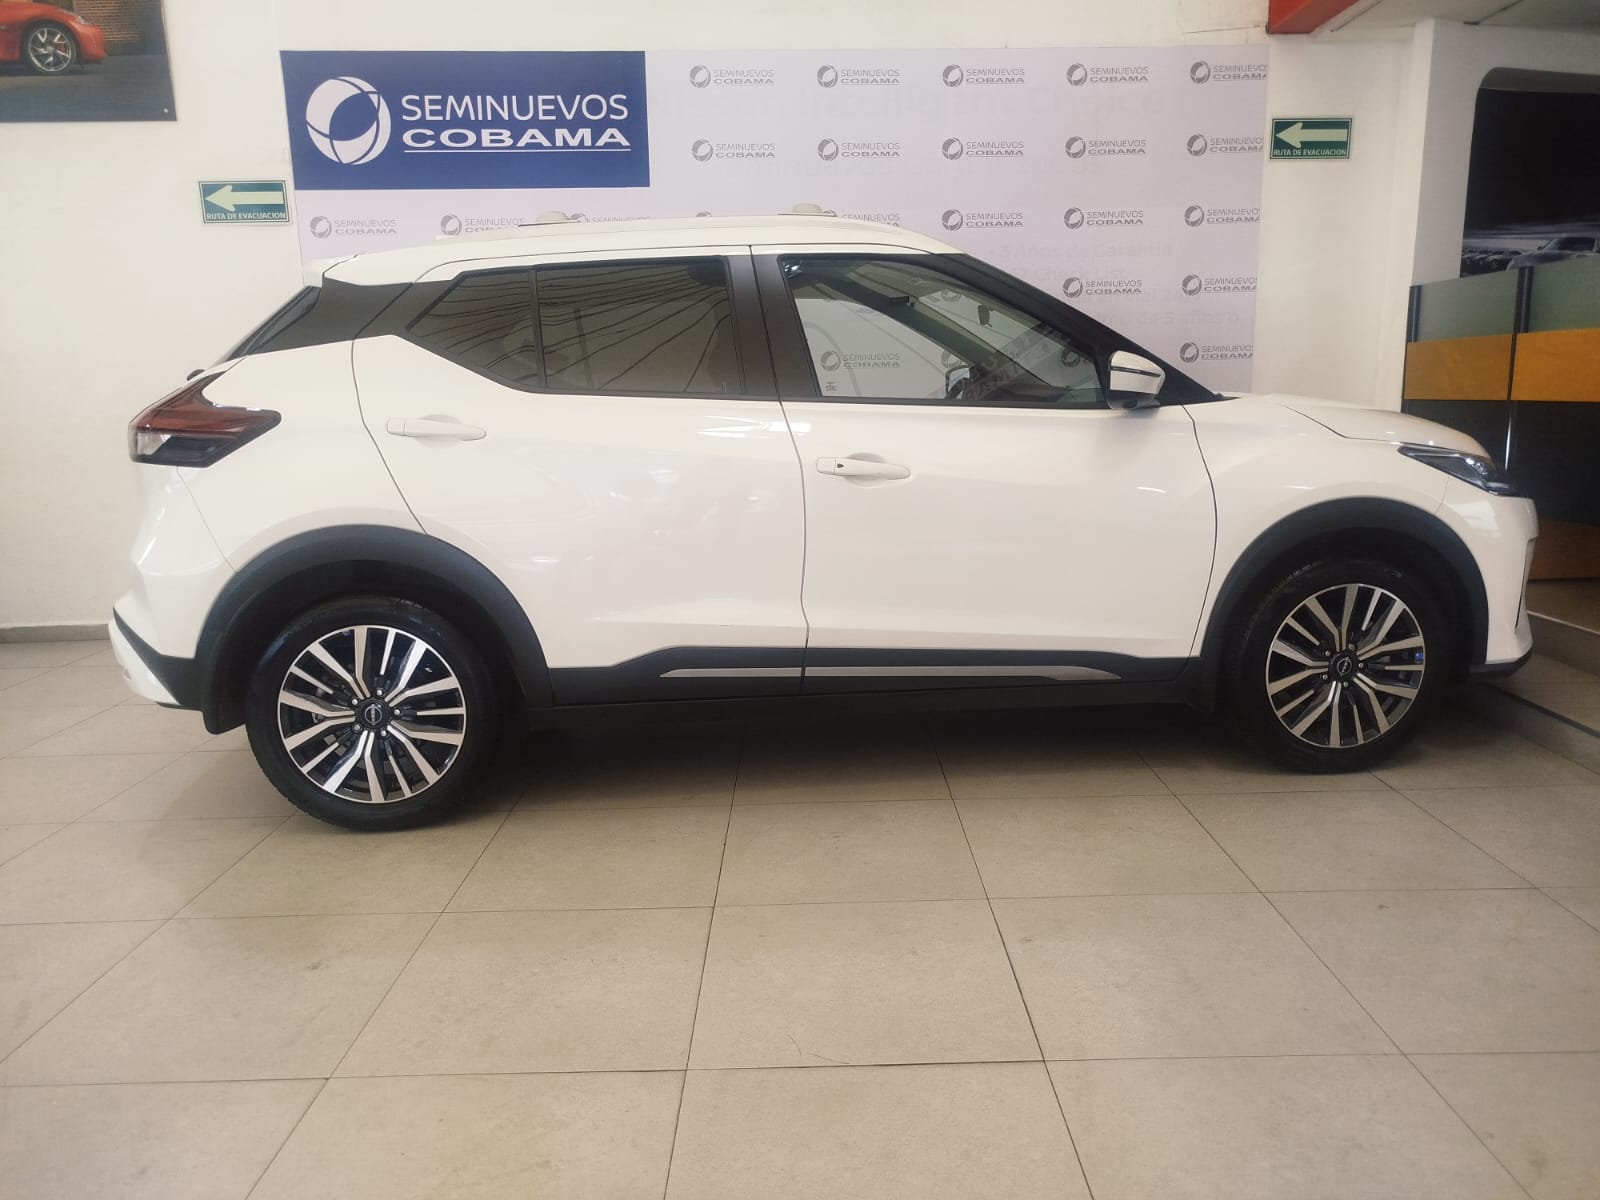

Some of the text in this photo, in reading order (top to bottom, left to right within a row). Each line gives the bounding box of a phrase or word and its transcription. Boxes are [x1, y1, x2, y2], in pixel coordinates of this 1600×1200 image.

[714, 69, 774, 77] SEMINUEVOS
[840, 69, 900, 77] SEMINUEVOS
[966, 68, 1024, 76] SEMINUEVOS
[1090, 67, 1148, 75] SEMINUEVOS
[402, 94, 628, 121] SEMINUEVOS
[403, 128, 630, 148] COBAMA
[1210, 137, 1264, 145] SEMINUEVO
[715, 143, 775, 151] SEMINUEVOS
[841, 142, 900, 150] SEMINUEVOS
[966, 141, 1024, 149] SEMINUEVOS
[1088, 140, 1146, 148] SEMINUEVOS
[966, 212, 1023, 220] SEMINUEVOS
[1087, 210, 1144, 218] SEMINUEVOS
[1207, 208, 1260, 216] SEMINUEVO
[335, 220, 397, 228] SEMINUEVOS
[1085, 279, 1142, 287] SEMINUEVOS
[1204, 277, 1257, 285] SEMINUEVO
